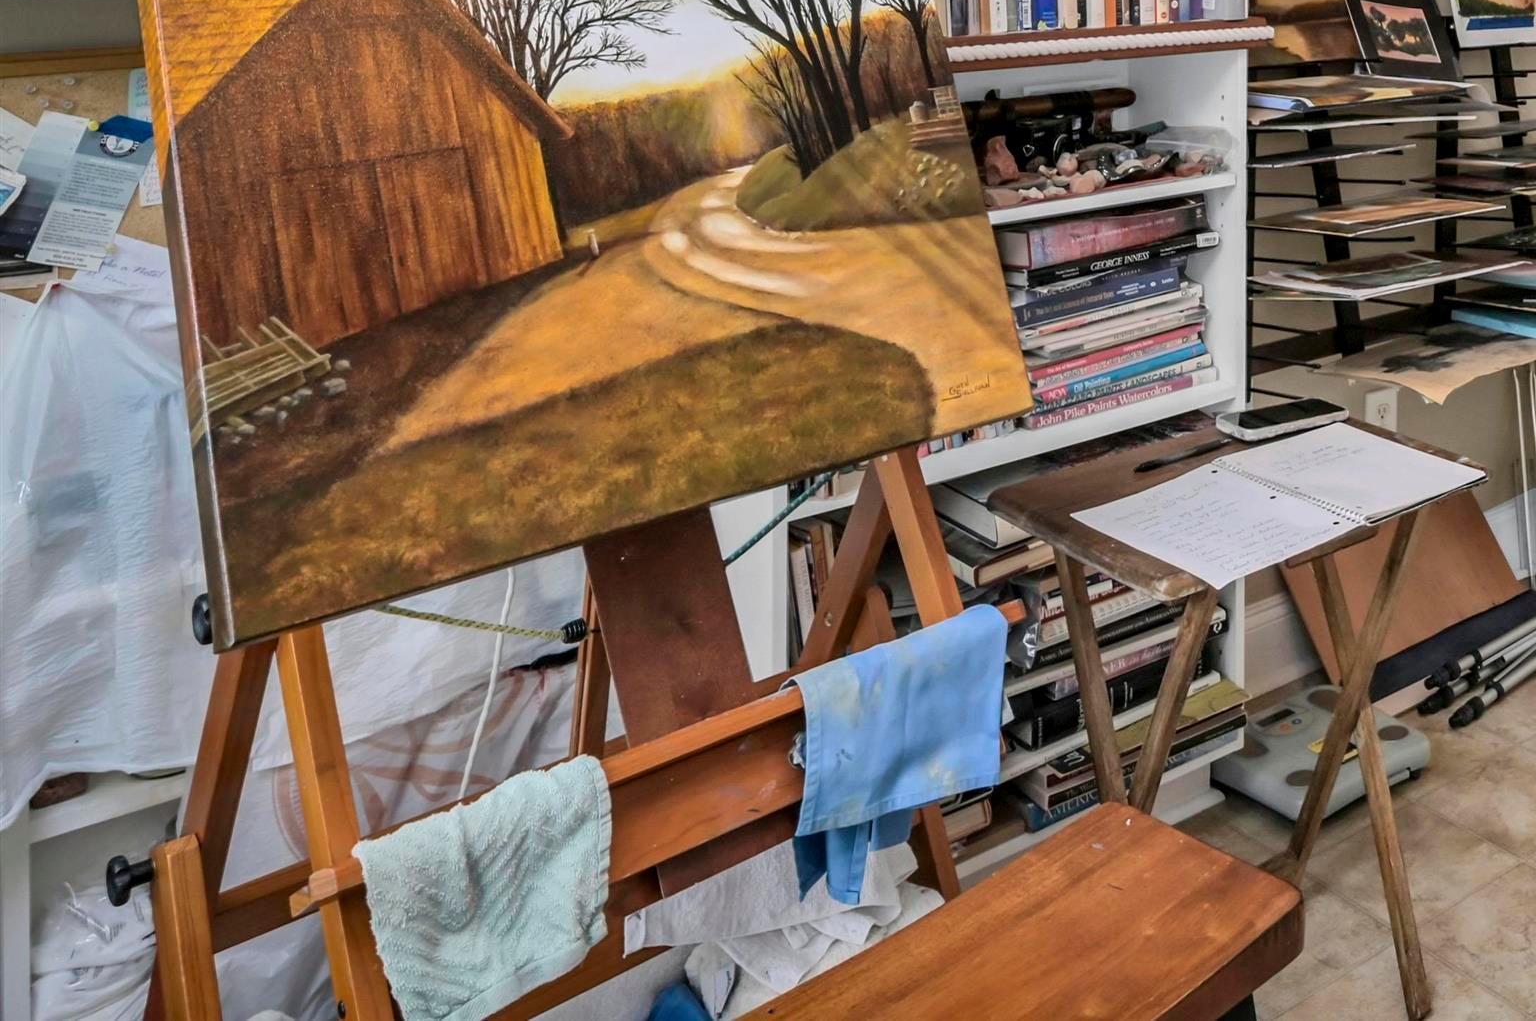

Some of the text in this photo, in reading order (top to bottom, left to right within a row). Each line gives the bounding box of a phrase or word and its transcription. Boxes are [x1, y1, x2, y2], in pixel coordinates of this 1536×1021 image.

[1089, 250, 1150, 271] GEORGE INNESS
[1123, 368, 1177, 389] LANDSCAPES
[1035, 379, 1173, 428] John Pike Paints Watercolors
[1041, 788, 1099, 823] AMERIC
